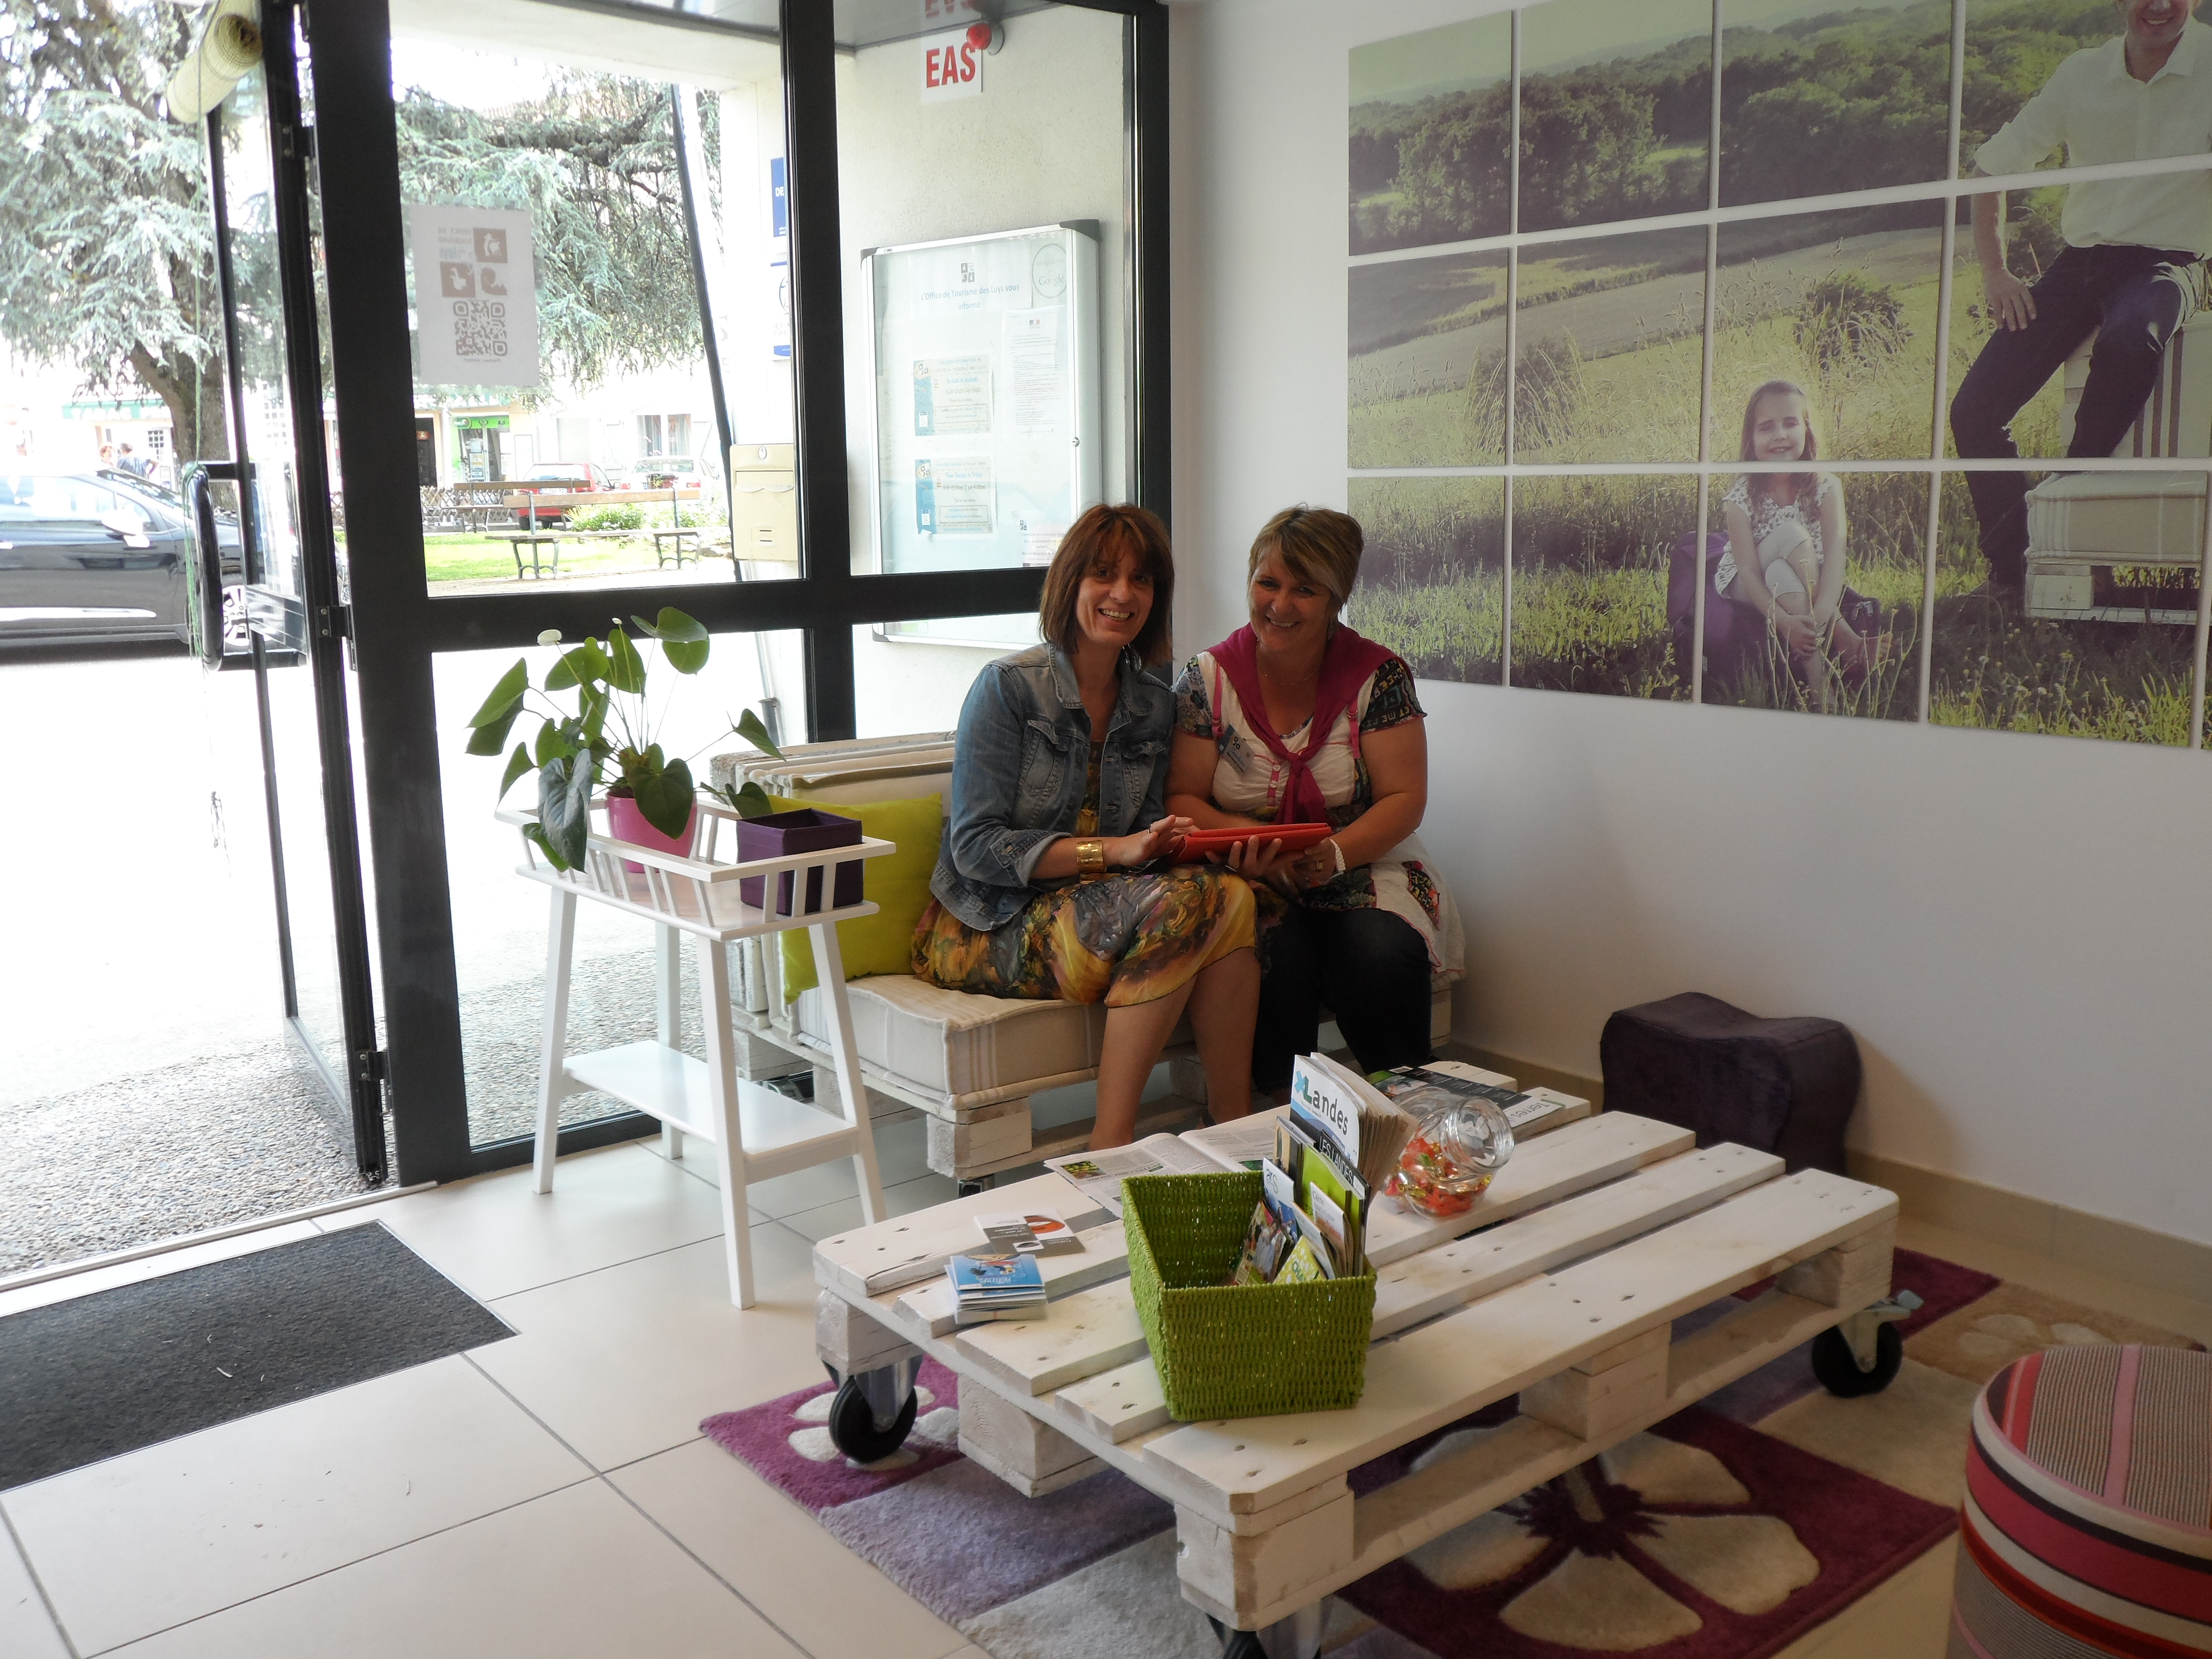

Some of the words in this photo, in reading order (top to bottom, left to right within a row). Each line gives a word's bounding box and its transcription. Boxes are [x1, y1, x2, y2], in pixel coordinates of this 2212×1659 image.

[926, 42, 976, 88] EAS
[1038, 274, 1064, 287] Google
[921, 292, 942, 300] L'Office
[951, 289, 978, 297] Tourisme
[71, 407, 132, 420] TABAC
[1511, 1100, 1551, 1118] Terres
[1319, 1136, 1331, 1158] LES
[1332, 1148, 1353, 1185] LANDES
